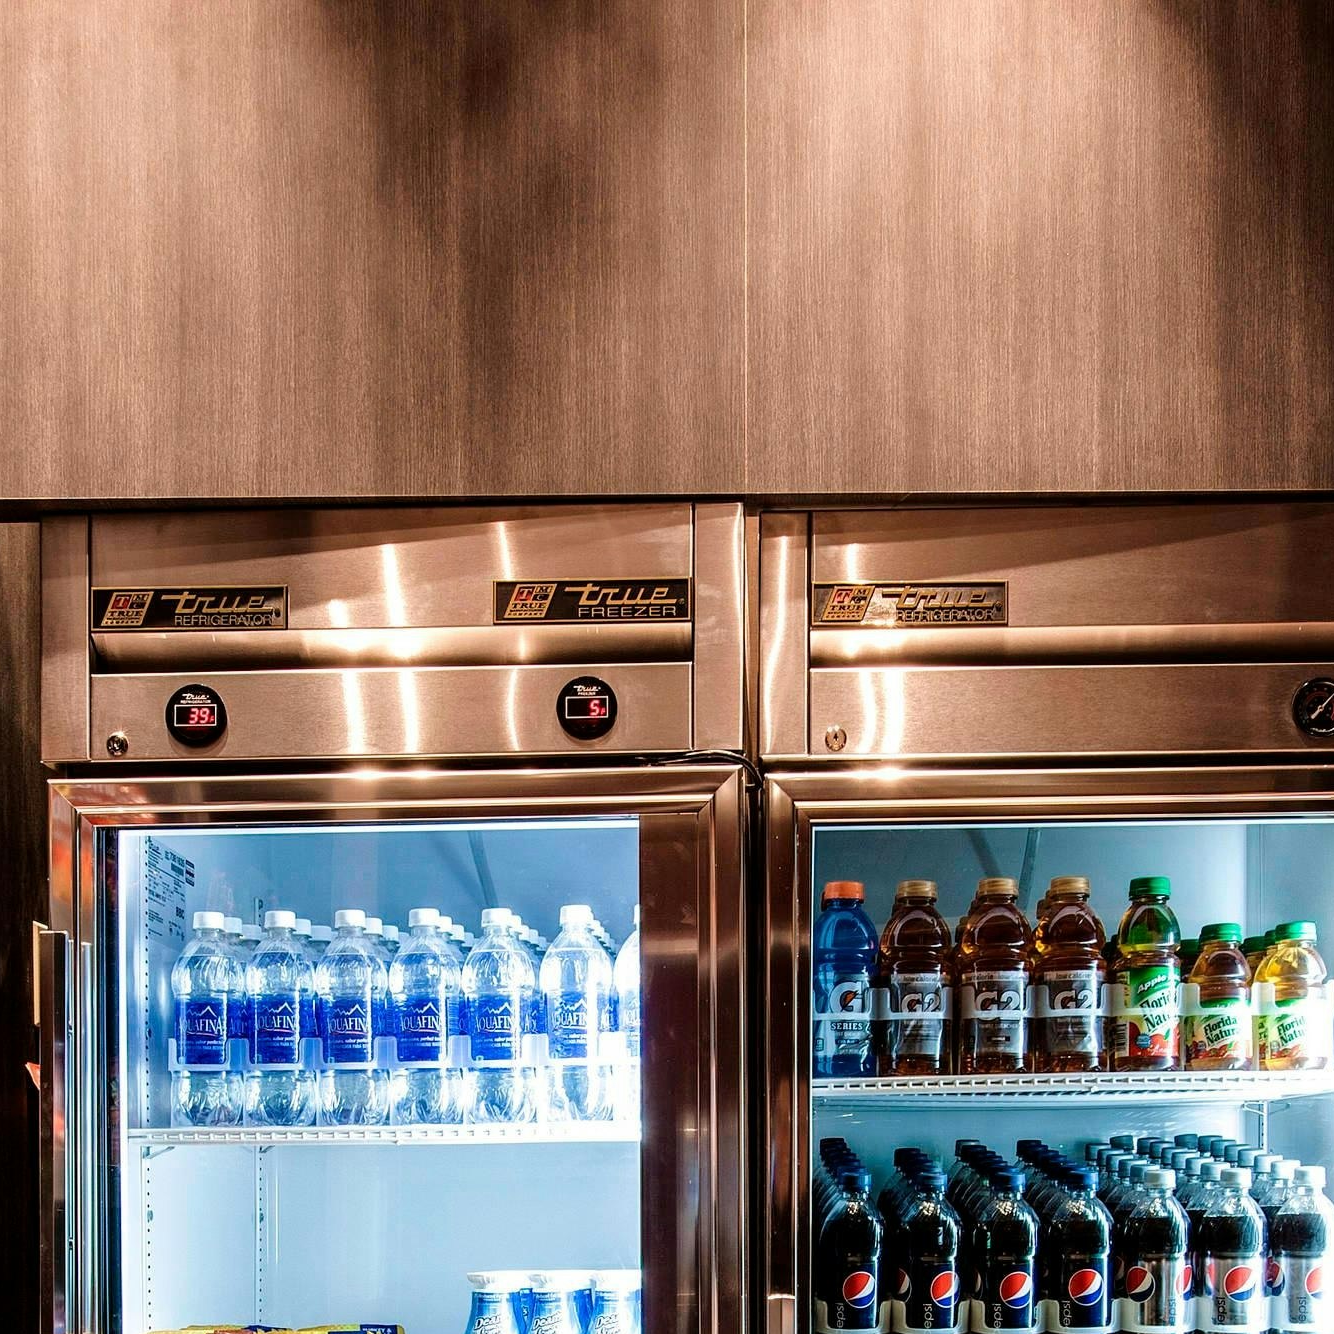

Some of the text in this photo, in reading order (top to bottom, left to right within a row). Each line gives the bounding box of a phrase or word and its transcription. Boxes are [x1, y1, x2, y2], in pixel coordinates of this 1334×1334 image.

[161, 592, 273, 613] true
[565, 583, 678, 605] true
[578, 606, 677, 617] FREEZER
[188, 708, 210, 724] 39
[1137, 973, 1168, 995] Apple
[975, 989, 1021, 1013] G2
[830, 1022, 864, 1032] SERIES
[1204, 1015, 1238, 1036] Florida
